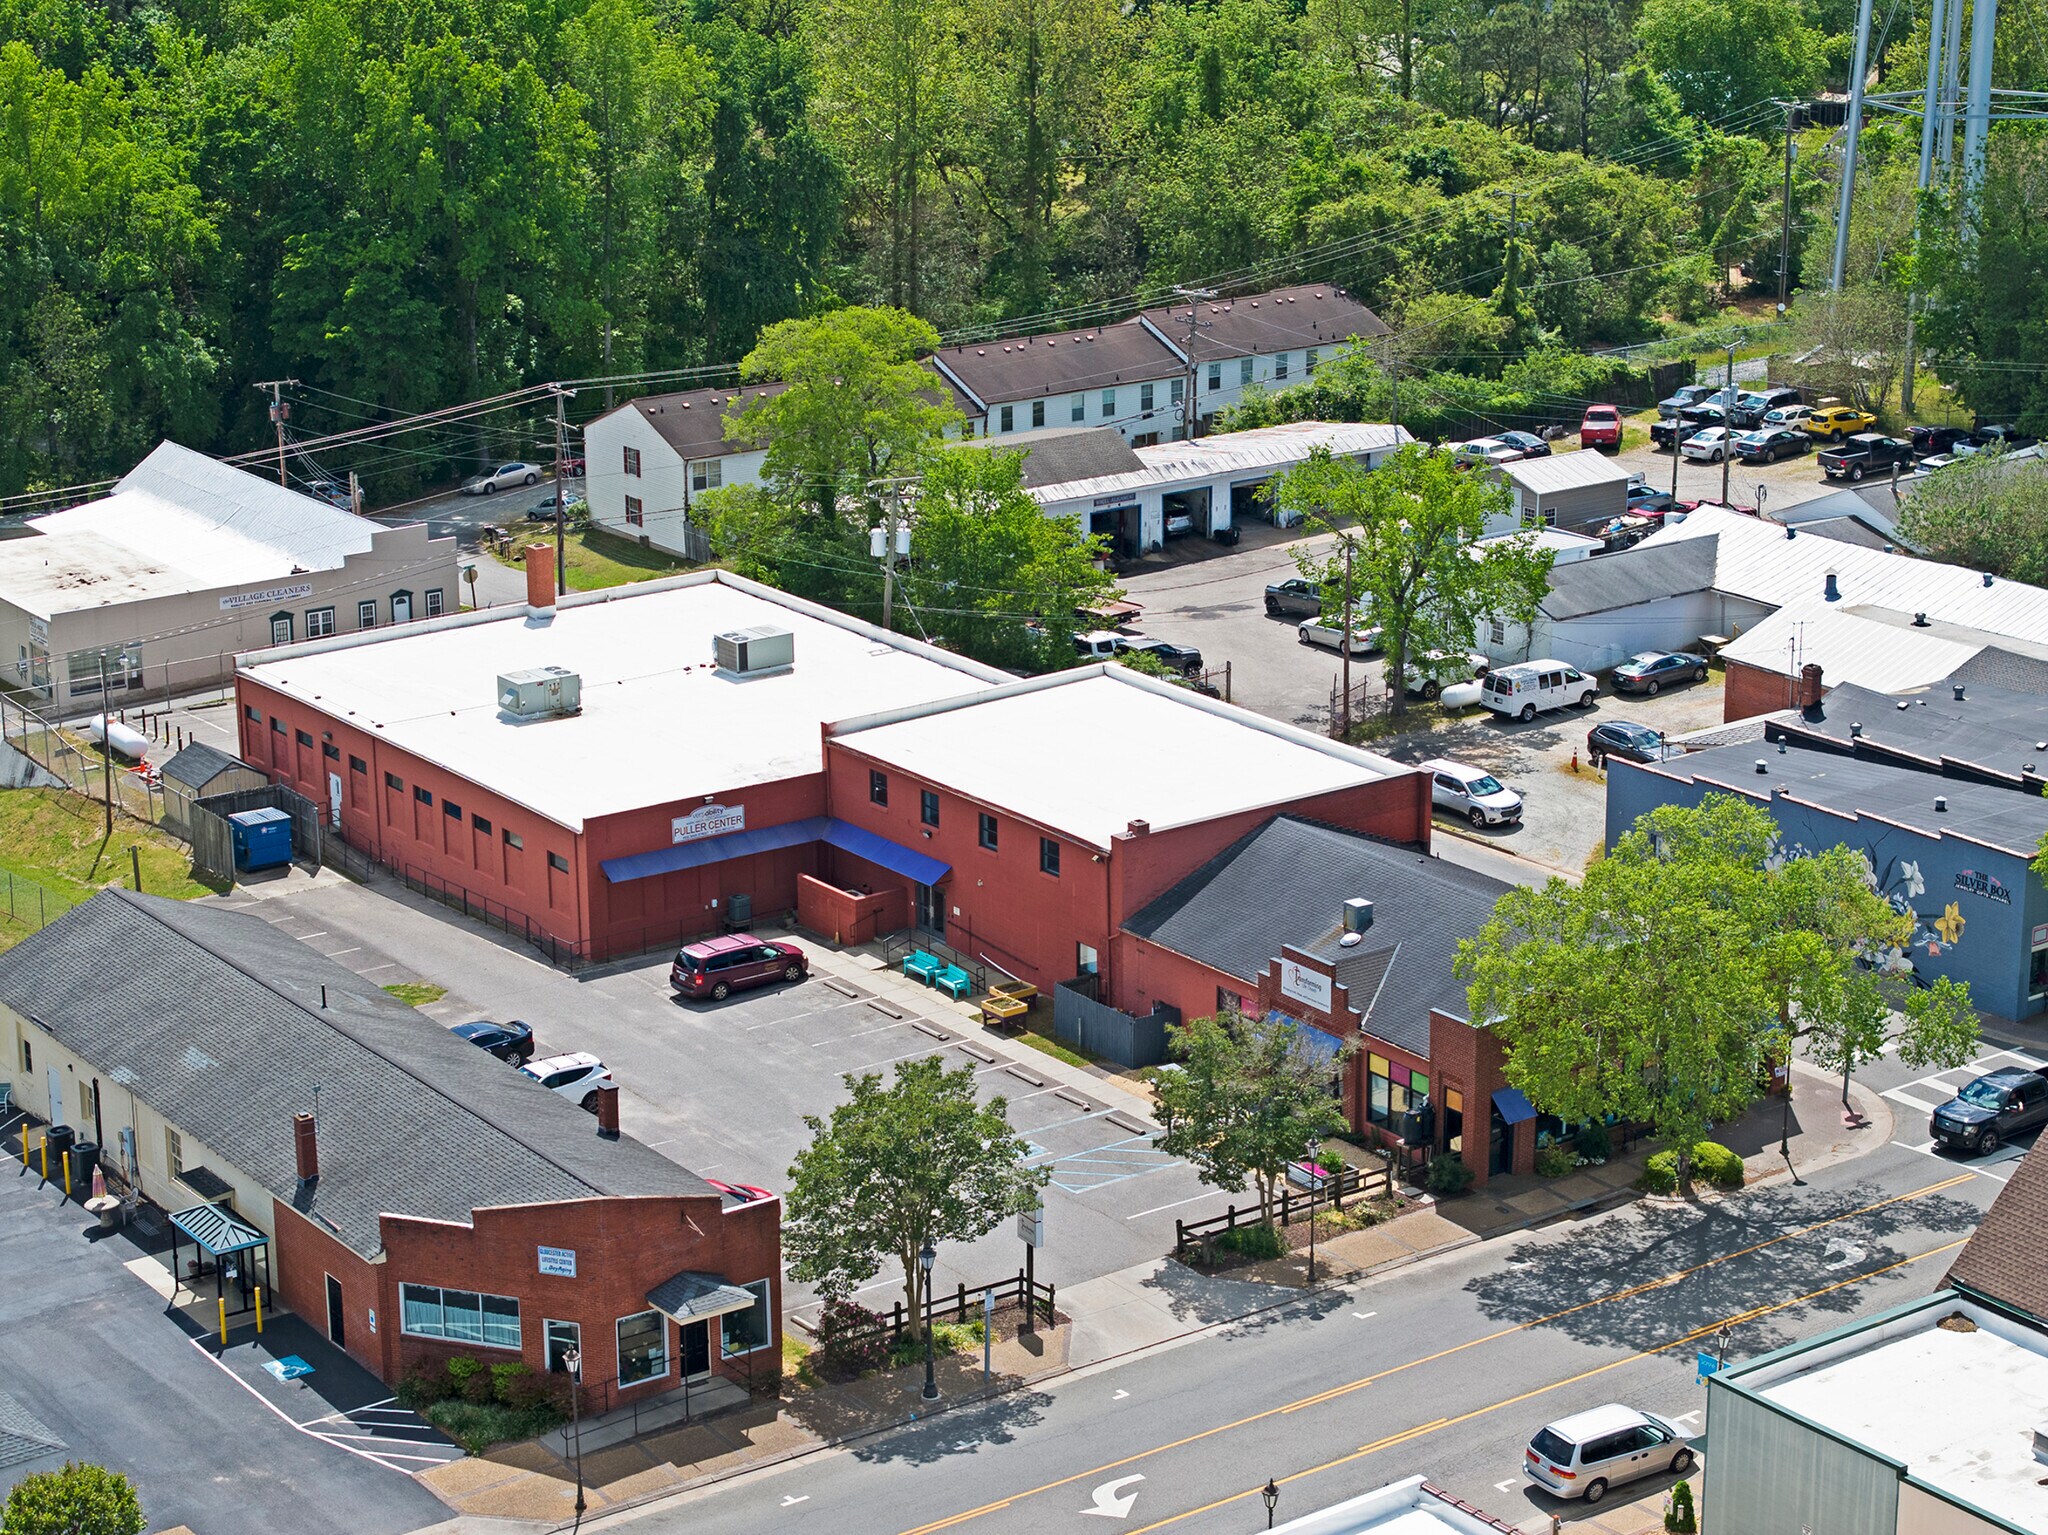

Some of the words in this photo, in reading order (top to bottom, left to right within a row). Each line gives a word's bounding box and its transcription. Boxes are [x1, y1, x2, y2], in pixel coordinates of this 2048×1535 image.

[229, 592, 265, 604] VILLAGE
[266, 584, 311, 598] CLEANERS
[674, 822, 707, 837] PULLER
[708, 815, 743, 830] CENTER
[1955, 873, 1989, 892] SILVER
[1990, 884, 2011, 900] BOX
[1975, 871, 1989, 882] THE
